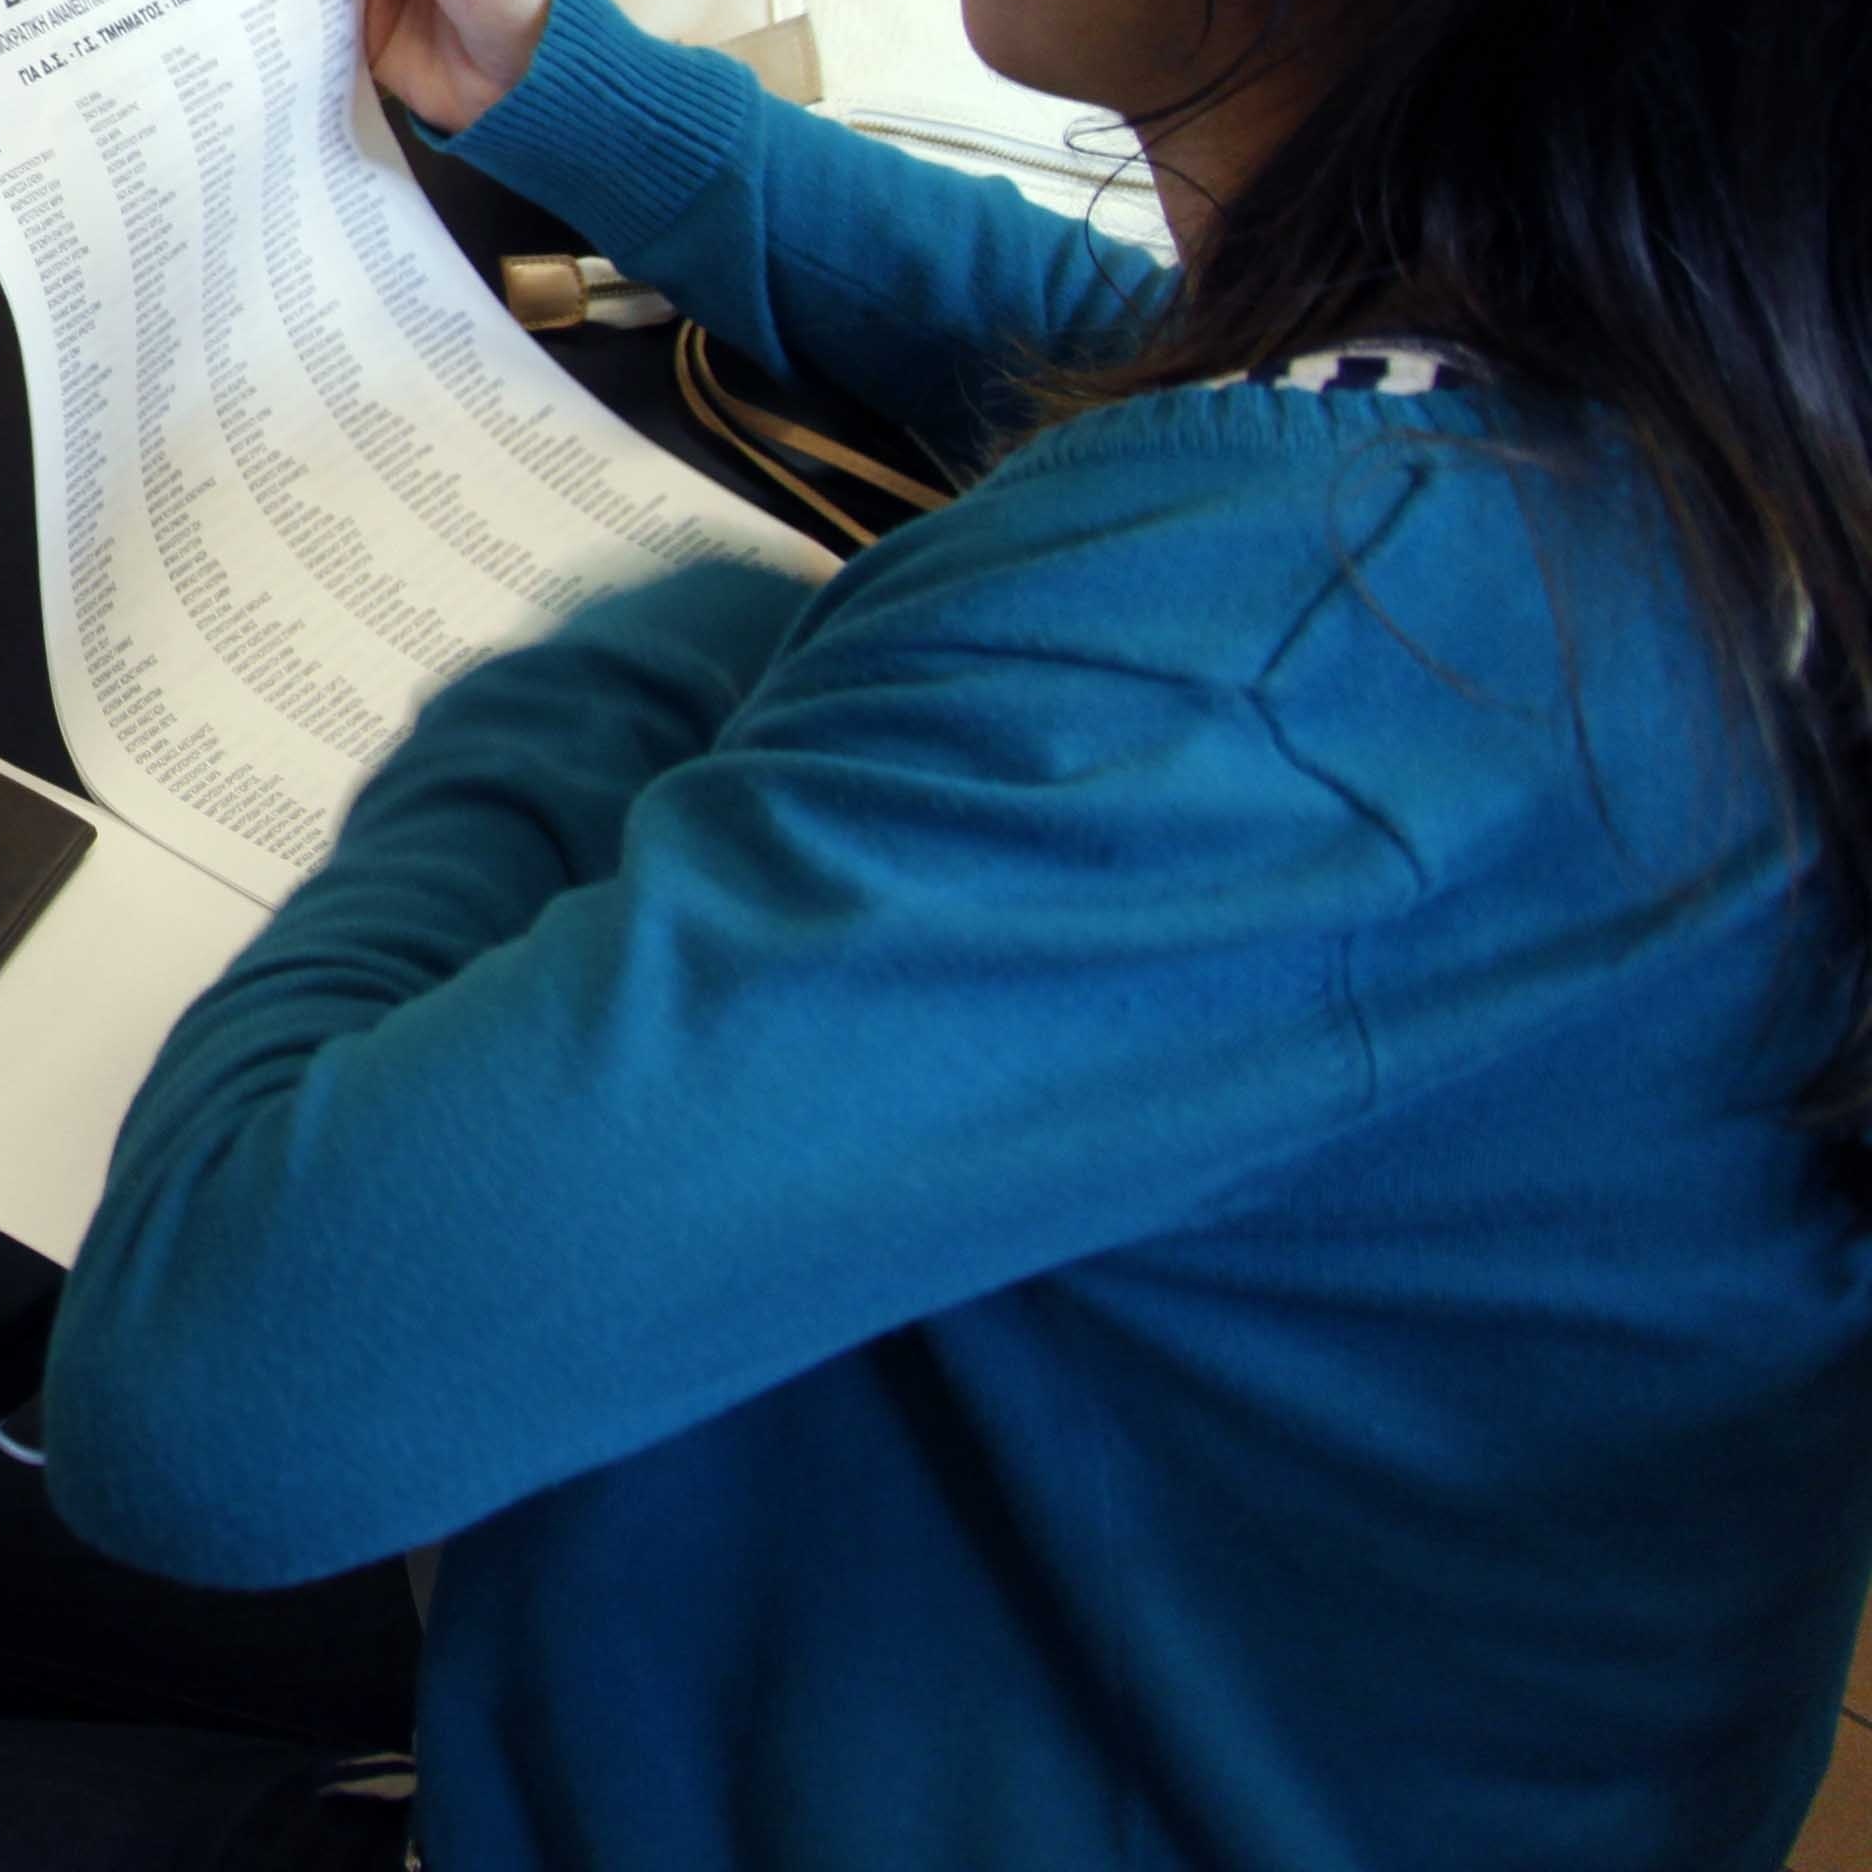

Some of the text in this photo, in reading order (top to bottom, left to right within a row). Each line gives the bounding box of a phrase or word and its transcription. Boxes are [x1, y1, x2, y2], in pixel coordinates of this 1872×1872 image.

[18, 64, 42, 86] ΓΙΑ
[40, 52, 68, 75] Δ.Σ.
[73, 36, 100, 57] Γ.Σ.
[96, 0, 165, 45] ΤΜΗΜΑΤΟΣ
